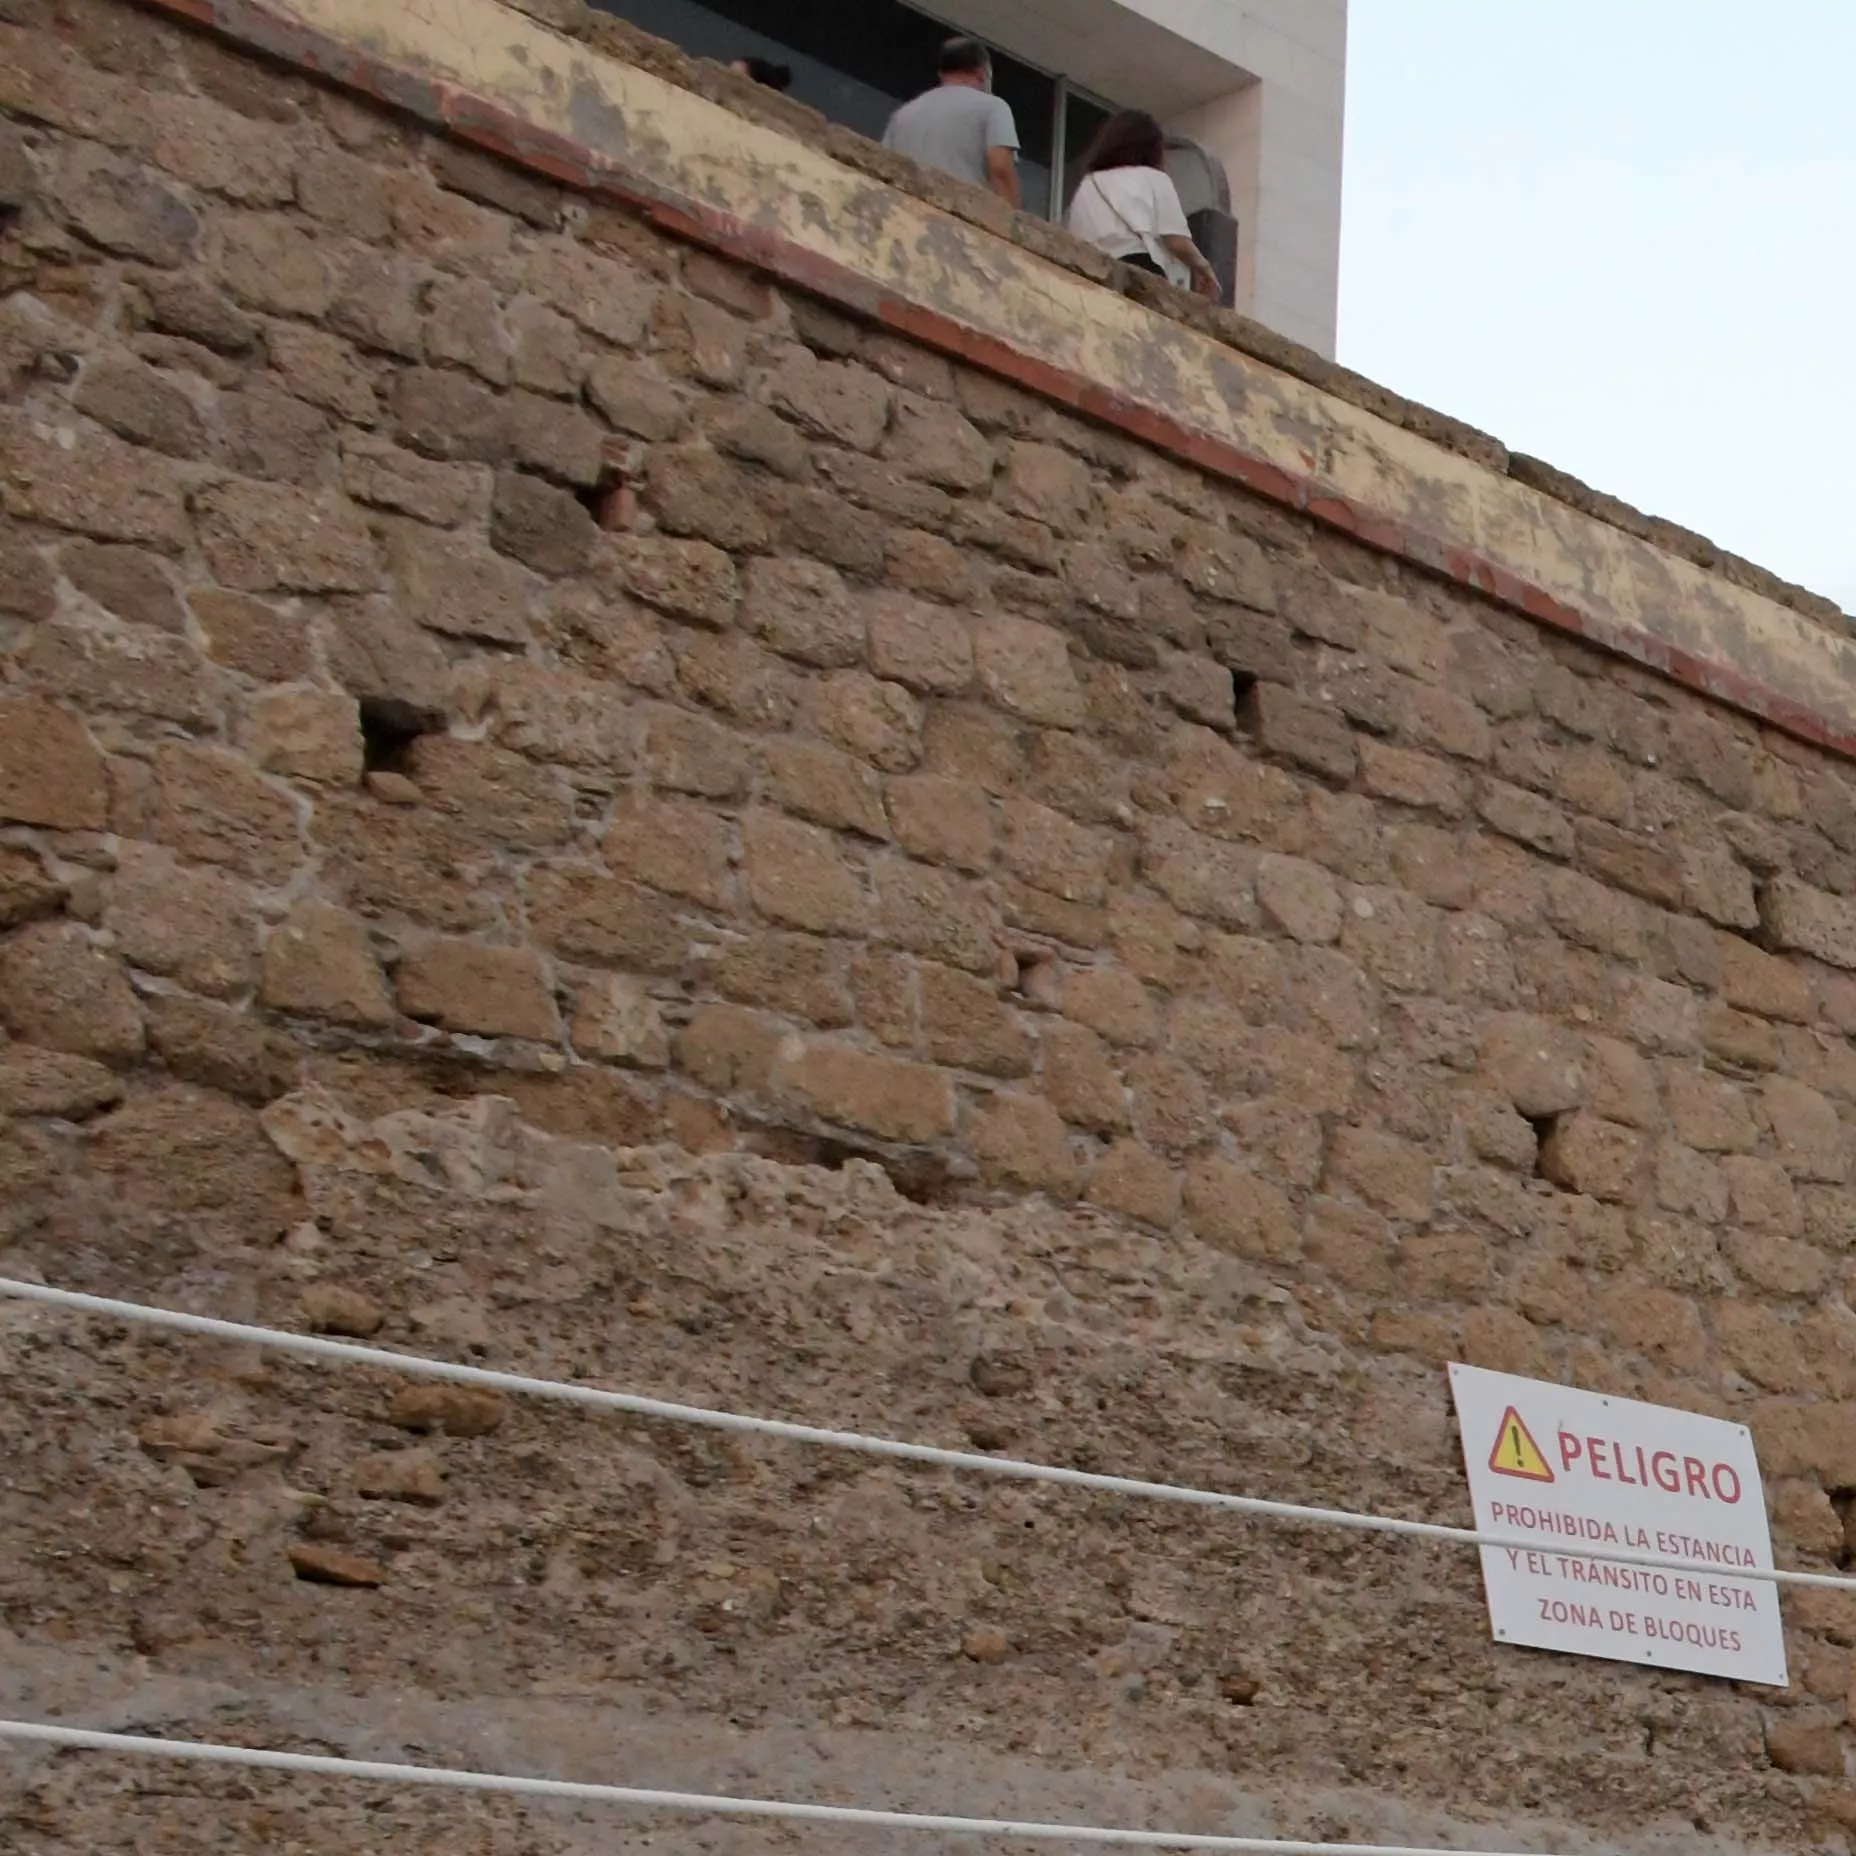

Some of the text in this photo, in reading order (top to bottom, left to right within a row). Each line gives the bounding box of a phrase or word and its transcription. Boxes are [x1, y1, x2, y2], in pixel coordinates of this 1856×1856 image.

[1558, 1431, 1742, 1505] PELIGRO
[1491, 1501, 1756, 1568] PROHIBIDA LA ESTANCIA
[1506, 1548, 1518, 1571] Y
[1527, 1552, 1552, 1576] EL
[1675, 1578, 1702, 1602] EN
[1708, 1584, 1757, 1611] ESTA
[1538, 1598, 1741, 1652] ZONA DE BLOQUES
